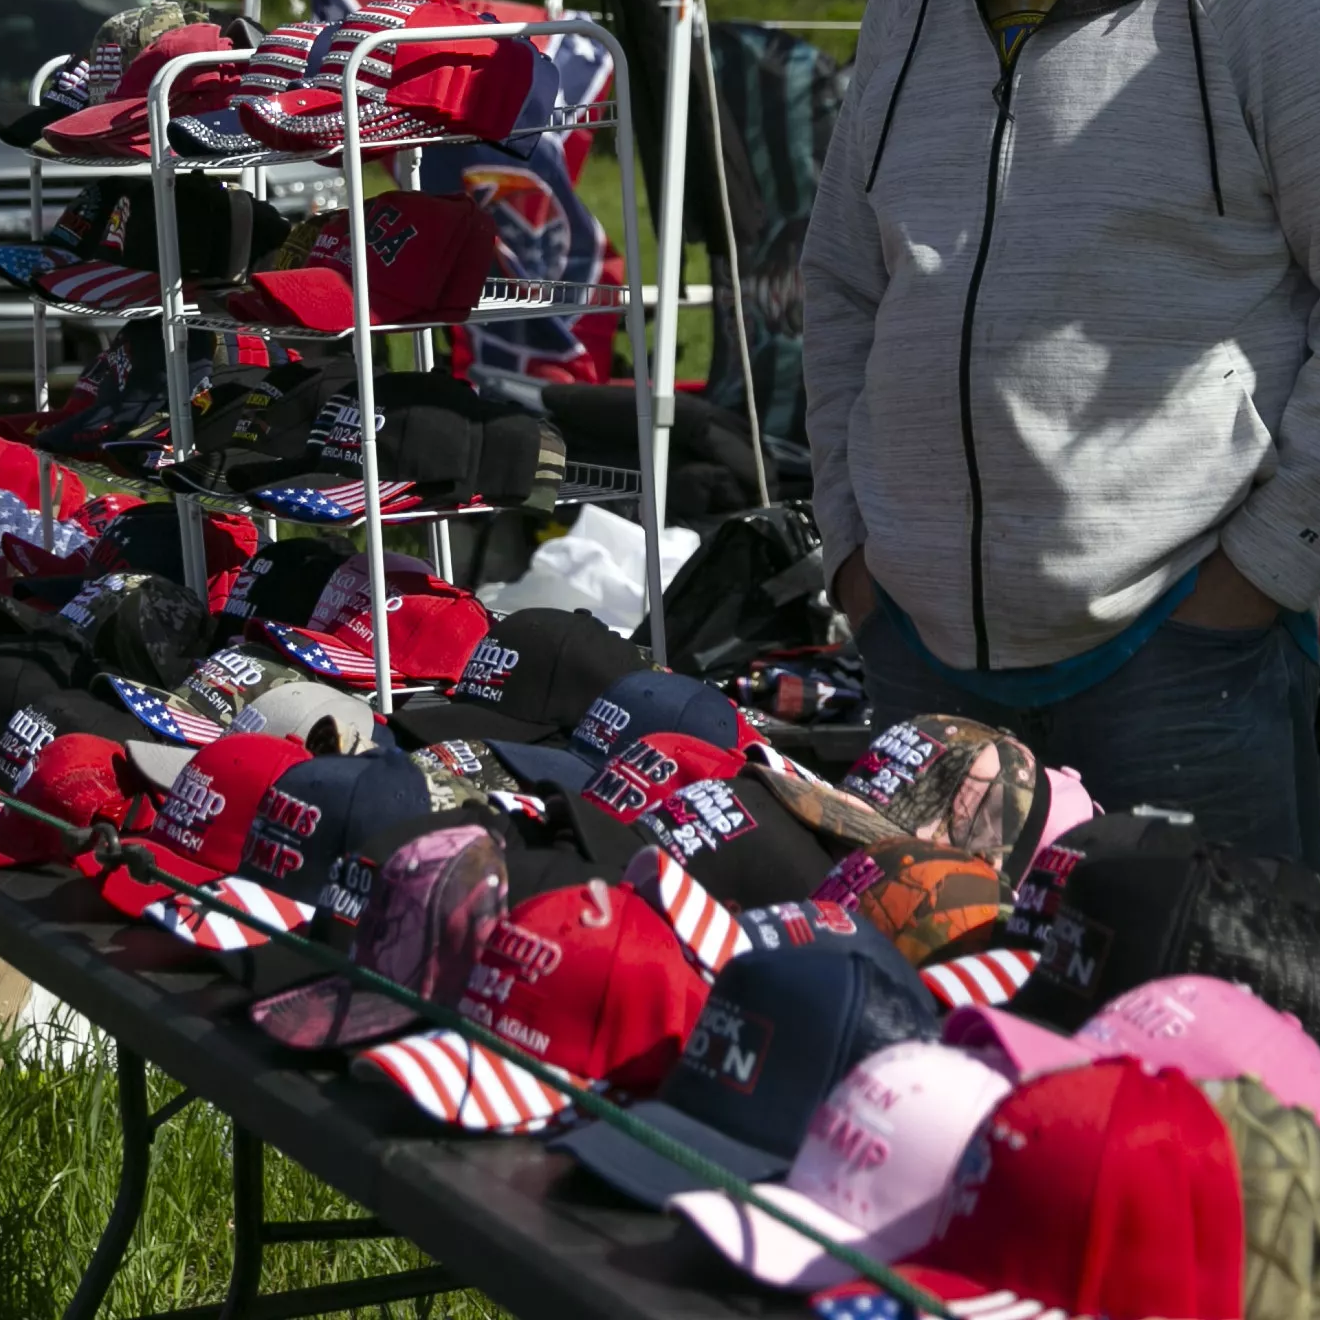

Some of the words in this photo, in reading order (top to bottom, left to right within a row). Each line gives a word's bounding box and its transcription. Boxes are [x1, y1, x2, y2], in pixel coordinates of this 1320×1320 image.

[252, 557, 275, 576] GO
[467, 682, 504, 702] BACK!
[726, 811, 744, 828] A
[166, 823, 205, 853] BACK!
[345, 861, 373, 894] GO
[494, 1012, 552, 1057] AGAIN
